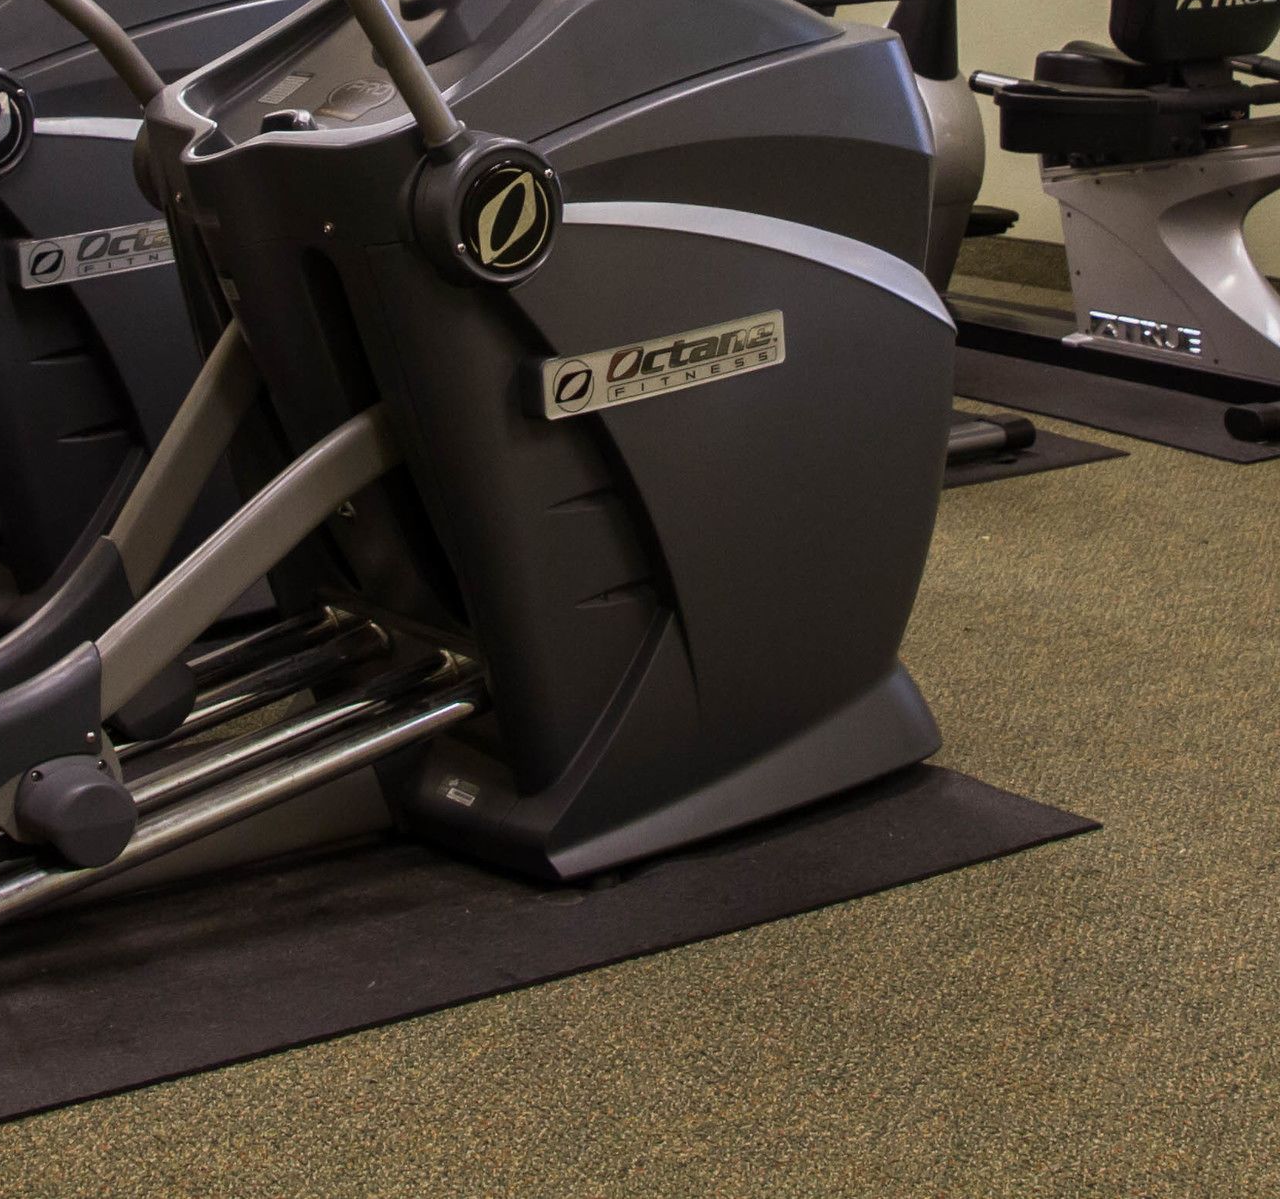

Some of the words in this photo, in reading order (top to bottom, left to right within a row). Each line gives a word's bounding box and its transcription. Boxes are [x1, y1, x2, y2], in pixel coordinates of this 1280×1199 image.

[607, 321, 776, 382] Octane
[1117, 316, 1201, 354] TRUE
[615, 352, 768, 397] FITNESS
